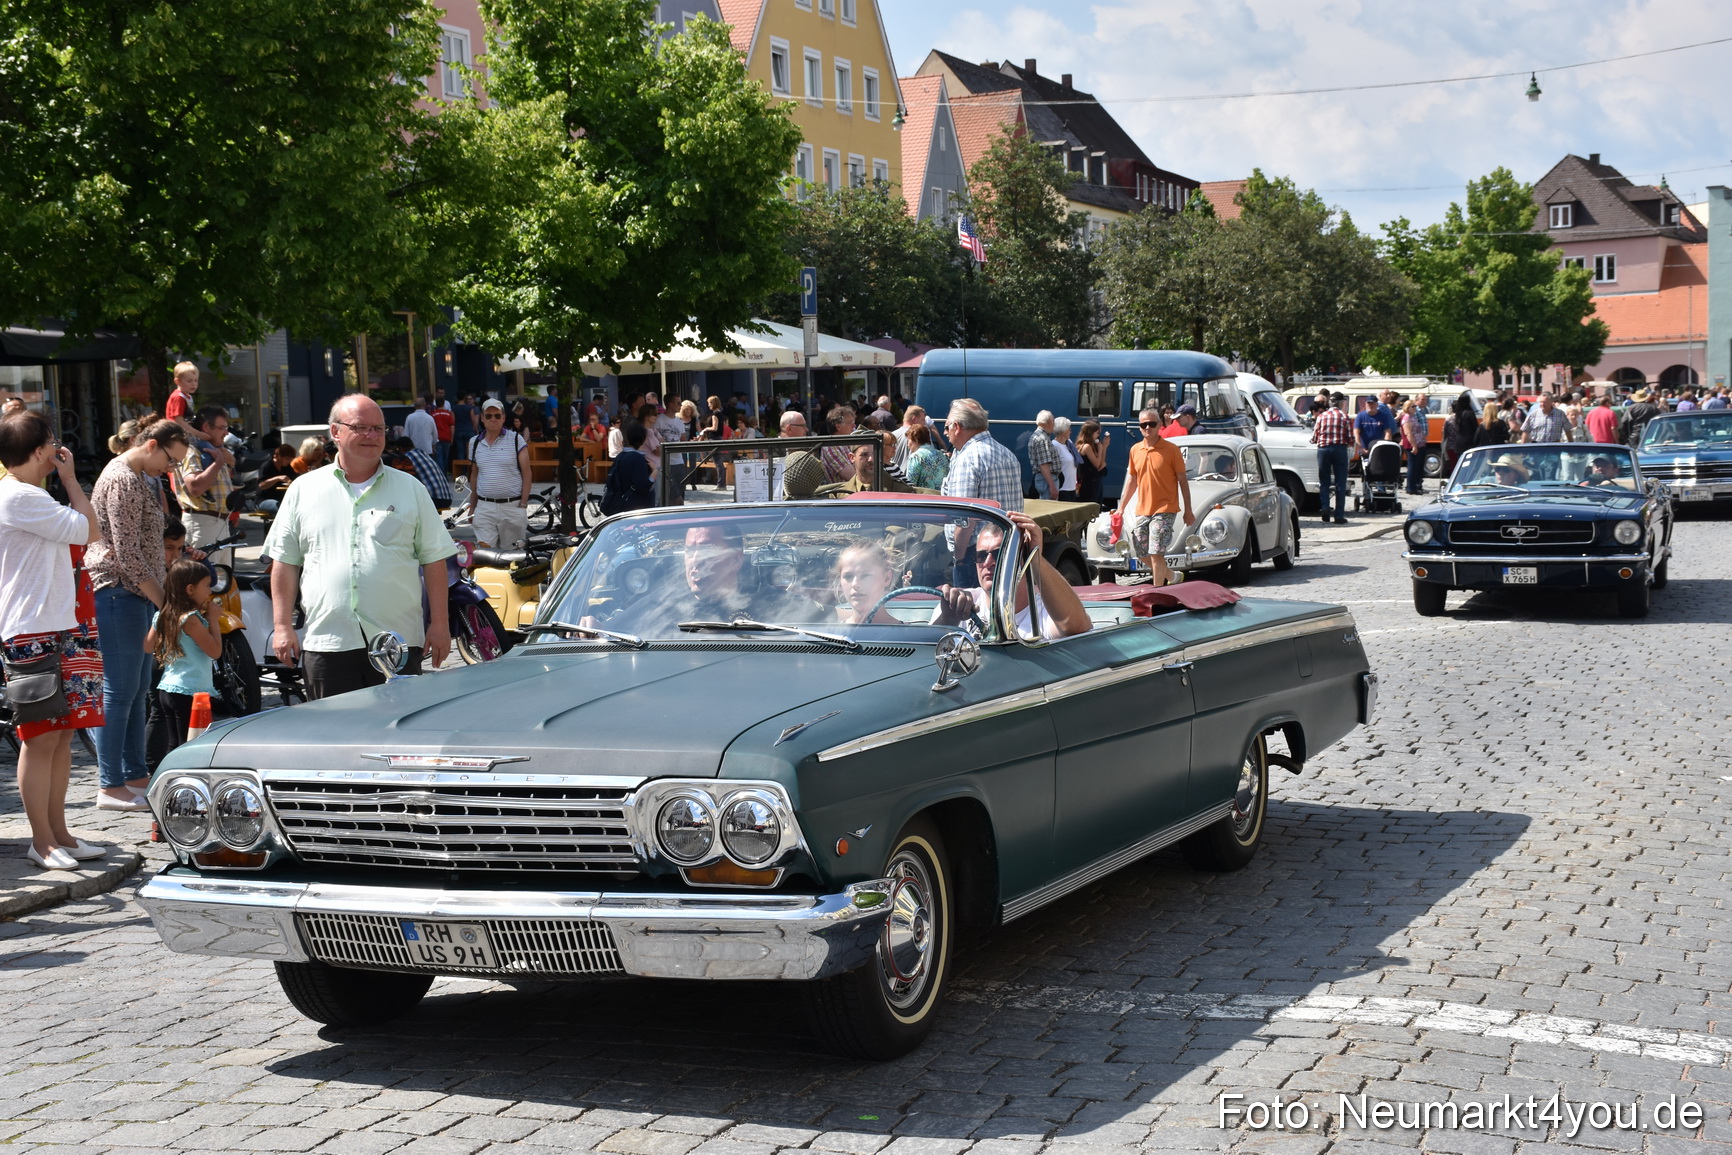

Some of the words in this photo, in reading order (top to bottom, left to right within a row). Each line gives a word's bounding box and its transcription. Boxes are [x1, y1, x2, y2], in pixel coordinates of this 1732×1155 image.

[804, 274, 813, 309] P
[824, 521, 862, 532] Francis
[1165, 557, 1179, 567] 97
[1510, 567, 1522, 575] SC
[316, 771, 569, 783] CHEVROLET
[421, 924, 453, 943] RH
[417, 944, 448, 963] US
